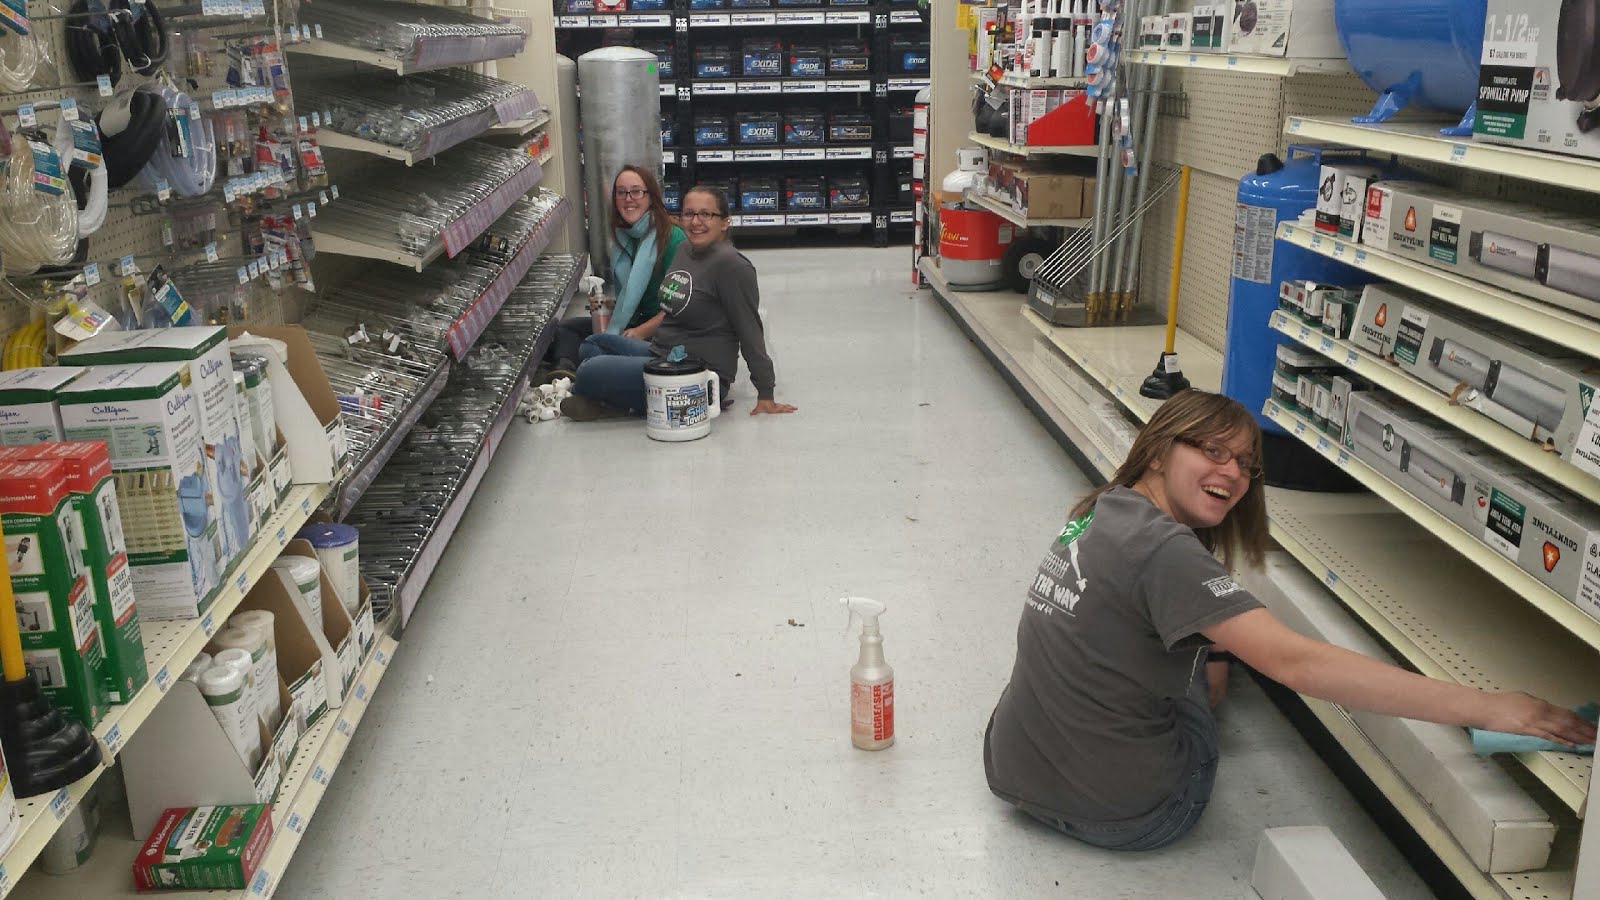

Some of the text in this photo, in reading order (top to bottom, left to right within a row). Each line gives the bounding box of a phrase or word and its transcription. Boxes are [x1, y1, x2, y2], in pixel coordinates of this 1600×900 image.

[752, 59, 779, 68] EXIDE
[1480, 86, 1509, 102] SPRINKLER
[1510, 88, 1529, 103] PUMP
[748, 127, 775, 136] EXIDE
[749, 197, 775, 205] EXIDE
[92, 405, 129, 416] Culligan
[1532, 517, 1578, 552] COUNTYLINE
[1034, 573, 1055, 598] THE
[1053, 584, 1080, 611] WAY
[873, 684, 883, 741] DEGREASER
